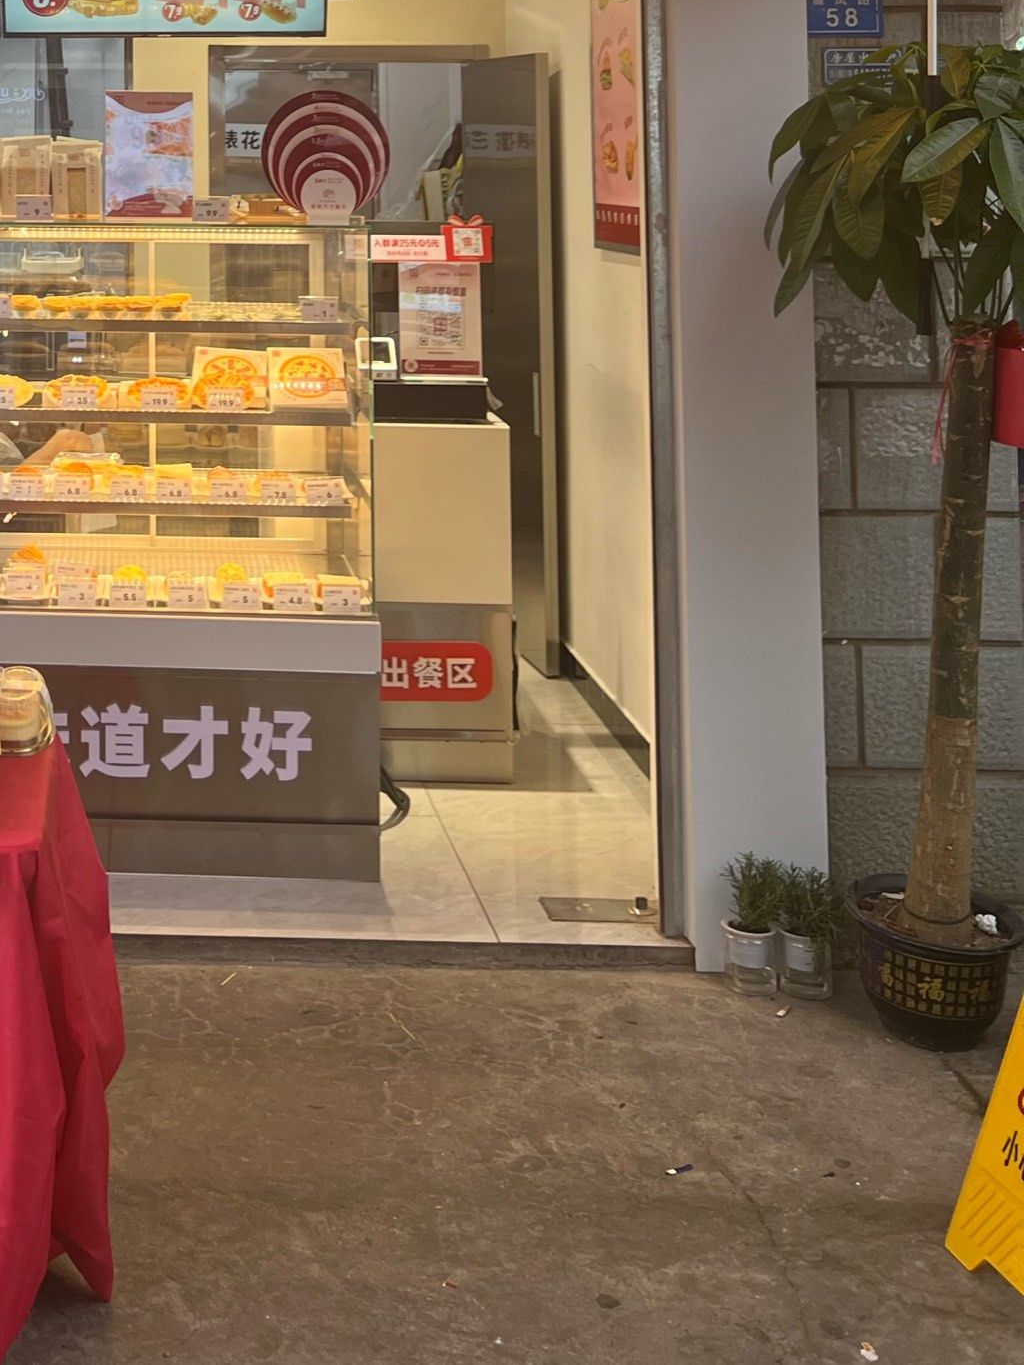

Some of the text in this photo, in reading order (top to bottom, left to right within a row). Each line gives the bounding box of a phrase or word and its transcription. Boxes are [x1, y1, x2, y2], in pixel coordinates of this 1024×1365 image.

[826, 8, 858, 27] 58
[152, 398, 168, 406] 19.9
[218, 399, 234, 407] 19.9
[67, 487, 80, 496] 6.8
[123, 593, 137, 601] 5.5
[382, 656, 478, 690] 出餐区
[52, 704, 313, 782] 道才好
